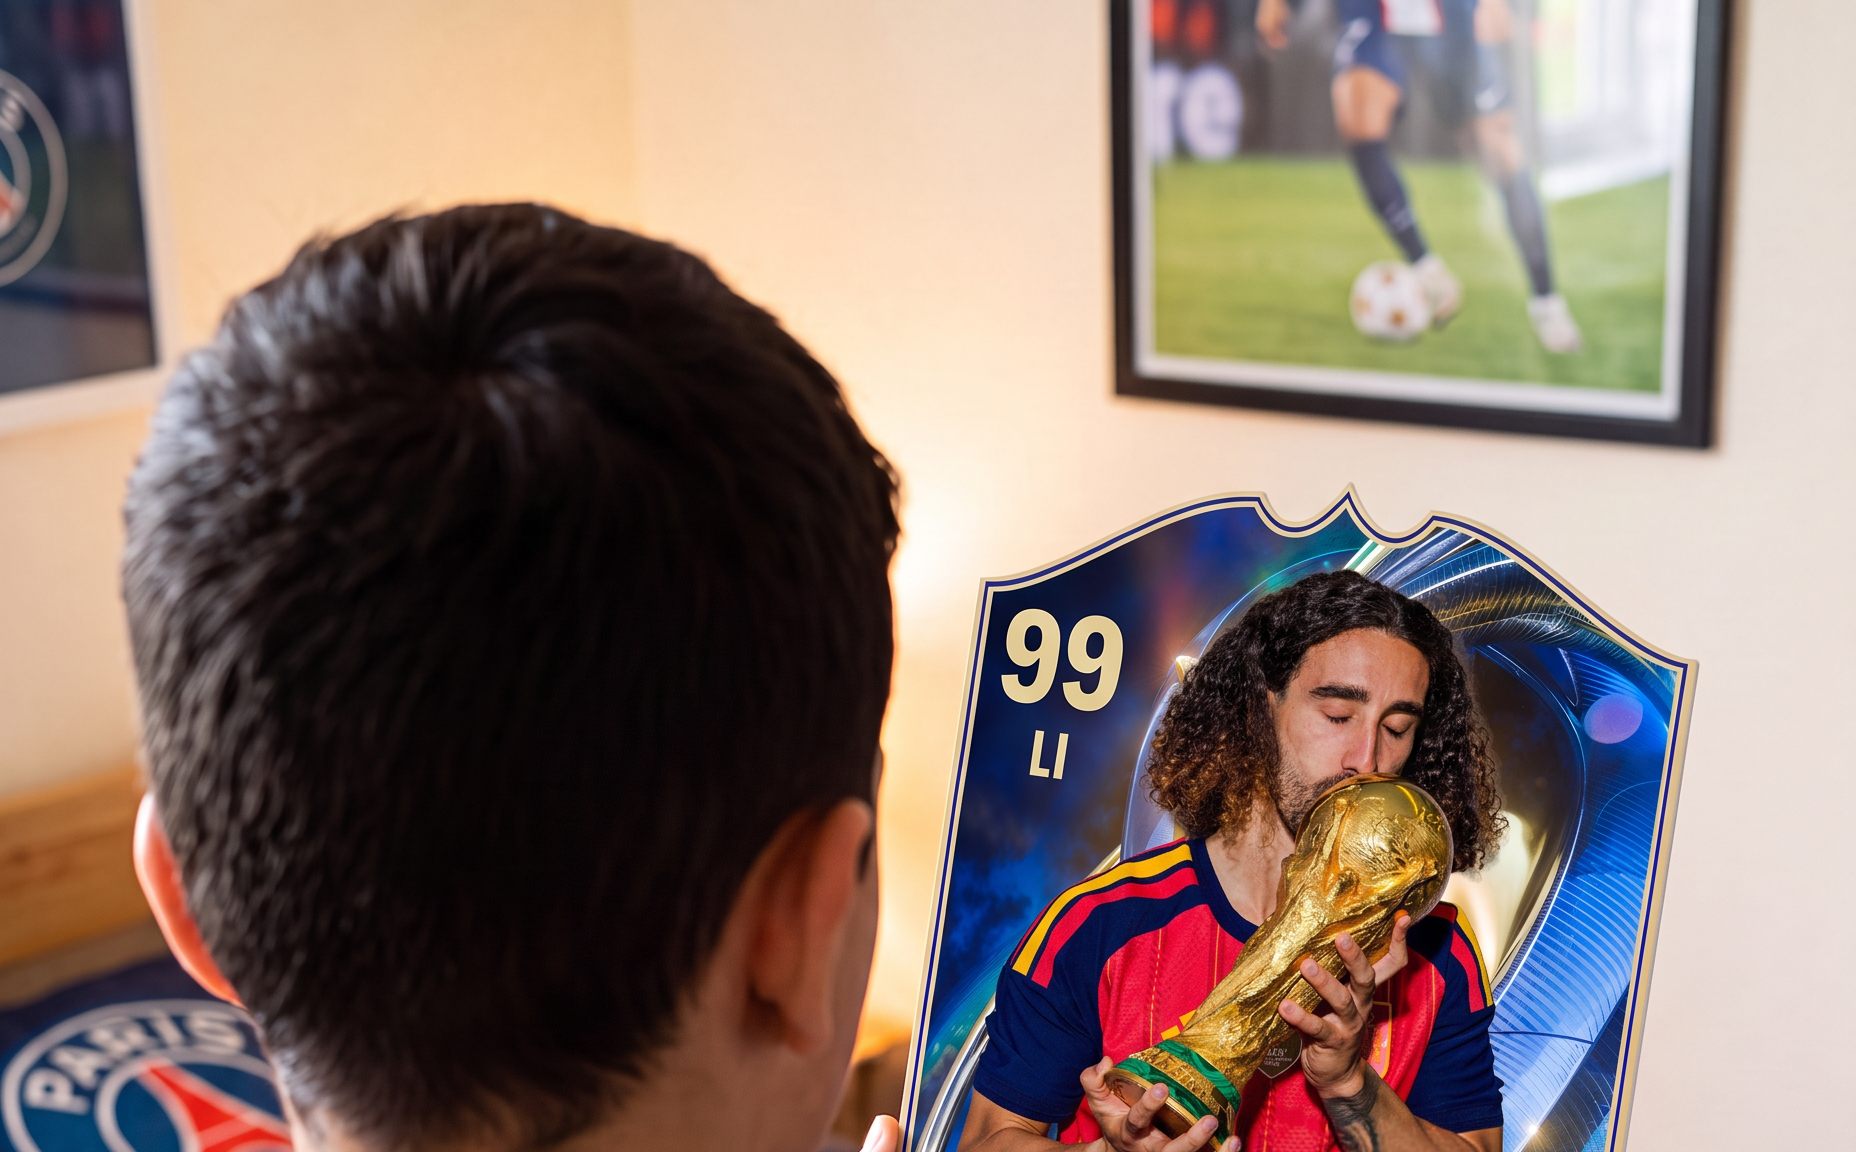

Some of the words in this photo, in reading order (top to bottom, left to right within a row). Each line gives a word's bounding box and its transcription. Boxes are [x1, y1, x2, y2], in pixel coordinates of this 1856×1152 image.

[1001, 608, 1124, 712] 99
[1029, 729, 1069, 780] LI
[24, 1008, 246, 1115] PARIS
